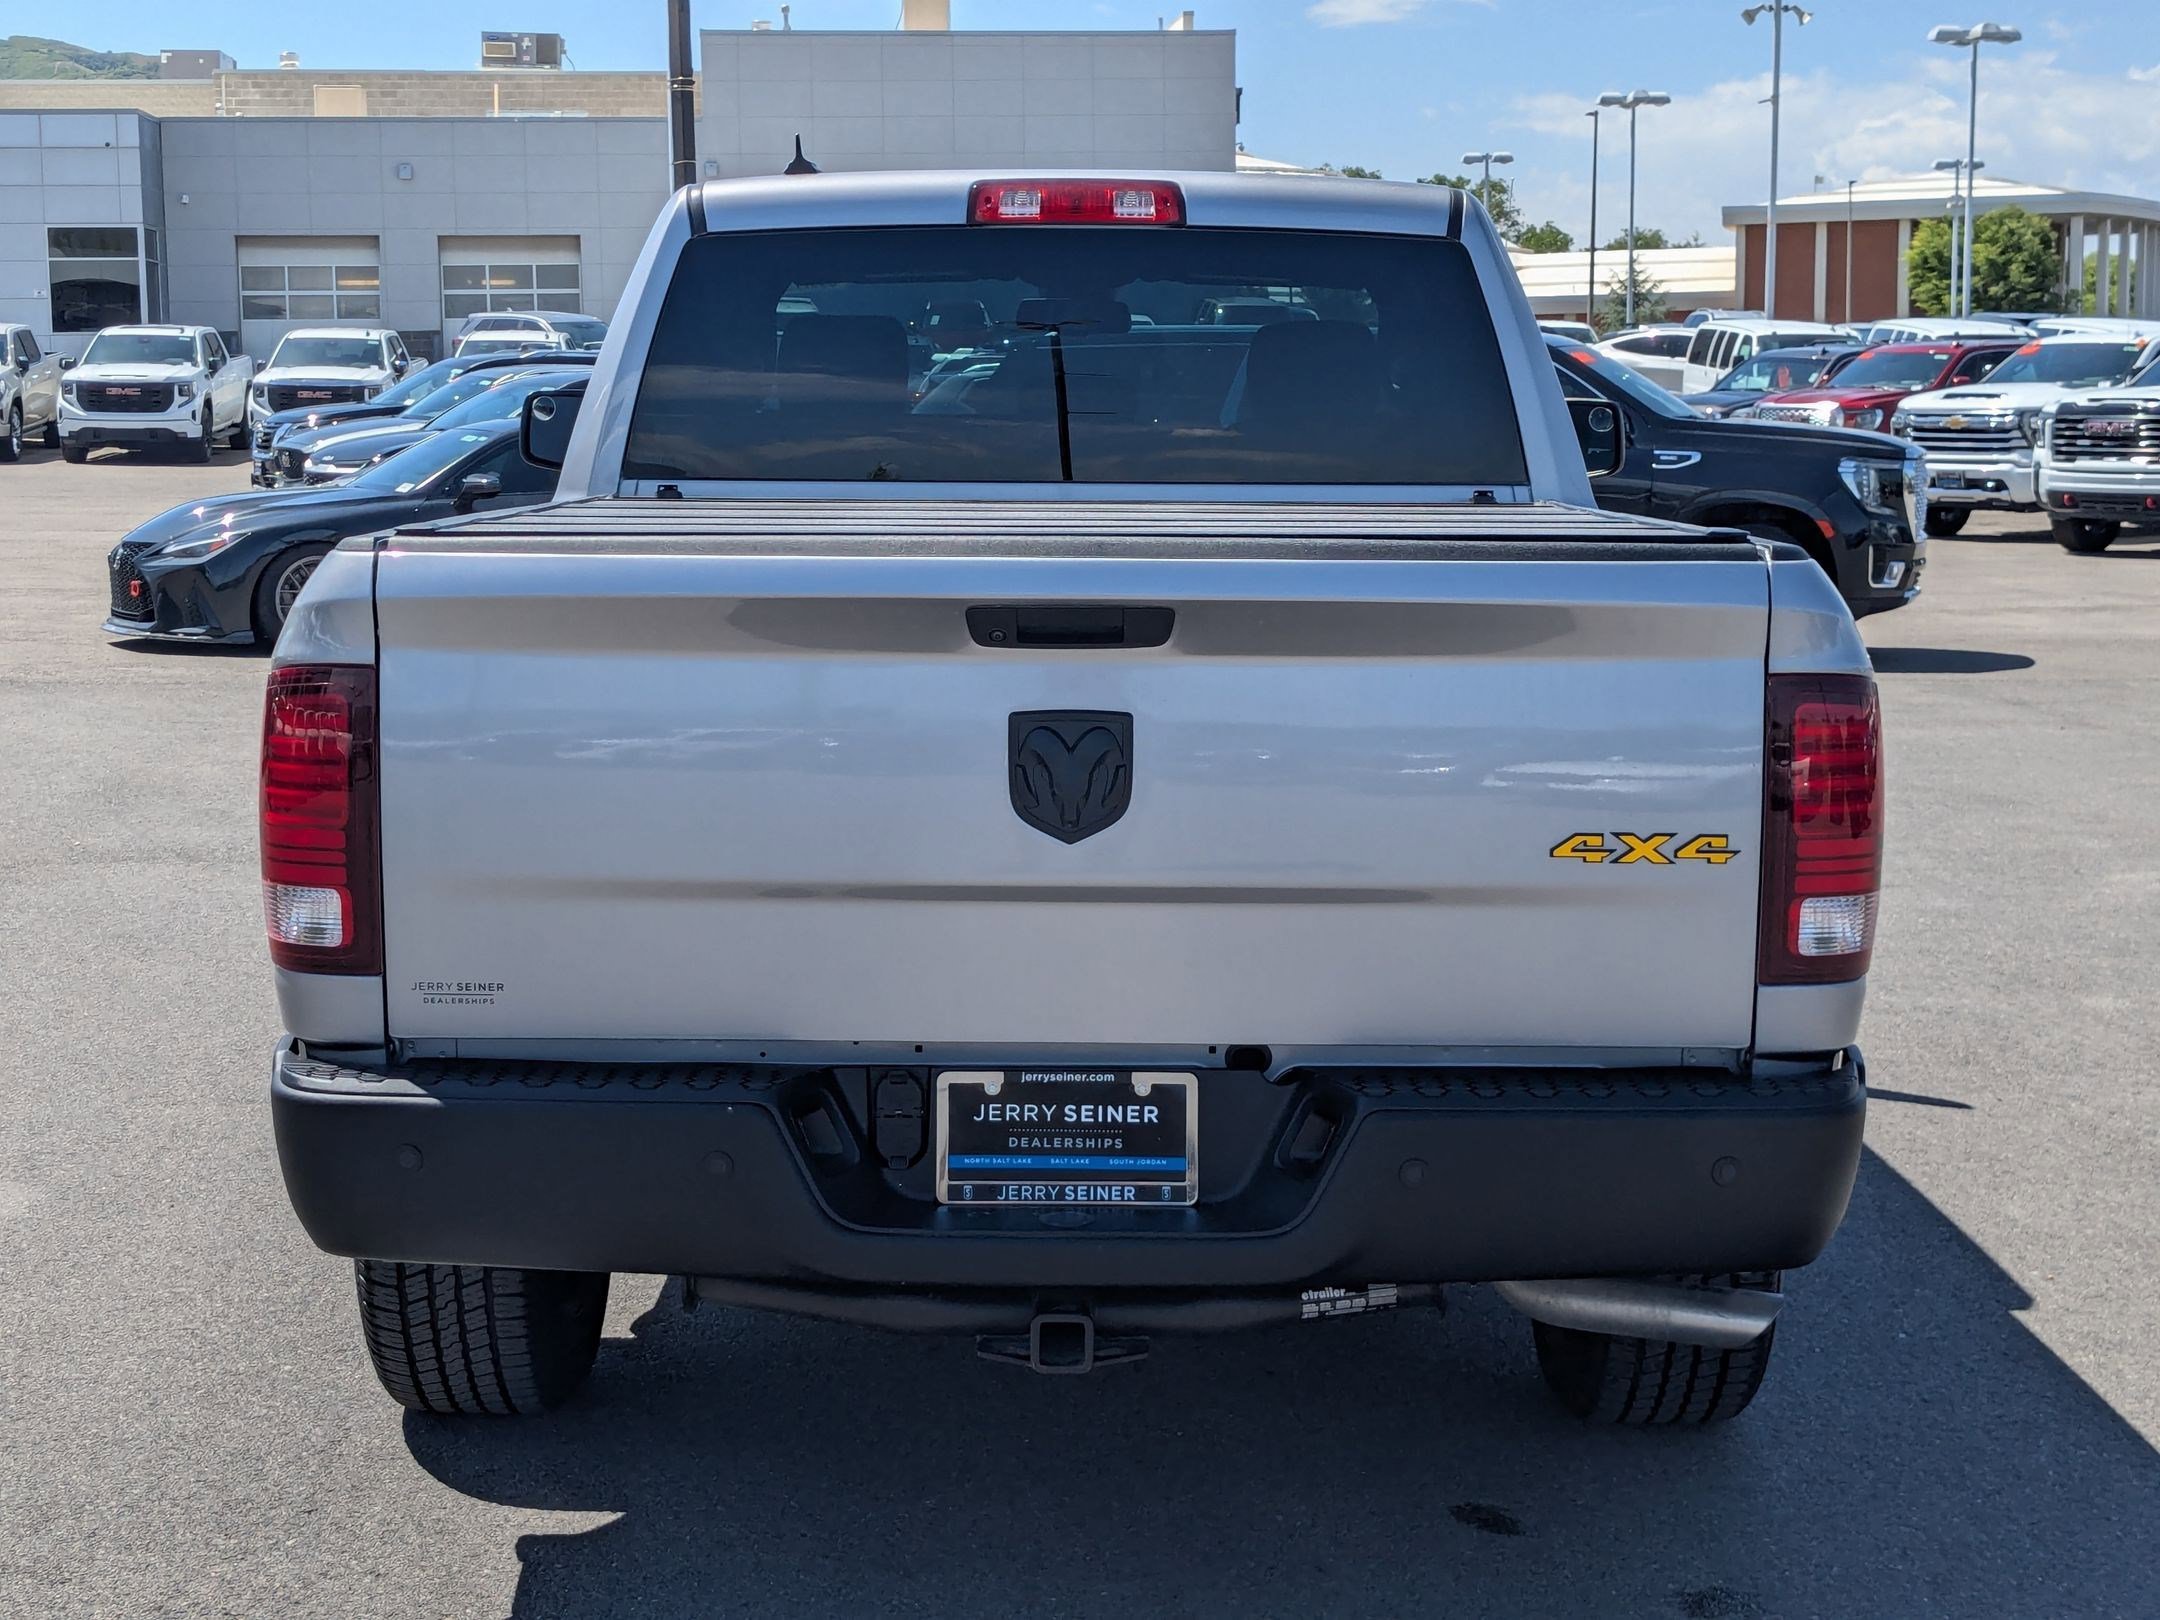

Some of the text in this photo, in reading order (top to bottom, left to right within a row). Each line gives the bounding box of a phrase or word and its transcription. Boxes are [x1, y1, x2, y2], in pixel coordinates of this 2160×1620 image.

[1549, 832, 1741, 865] 4X4
[411, 982, 505, 992] JERRY SEINER
[423, 997, 495, 1005] DEALERSHIPS
[1021, 1071, 1115, 1083] jerryseiner.com
[973, 1103, 1159, 1123] JERRY SEINER
[1008, 1137, 1123, 1149] DEALERSHIPS
[997, 1185, 1136, 1201] JERRY SEINER
